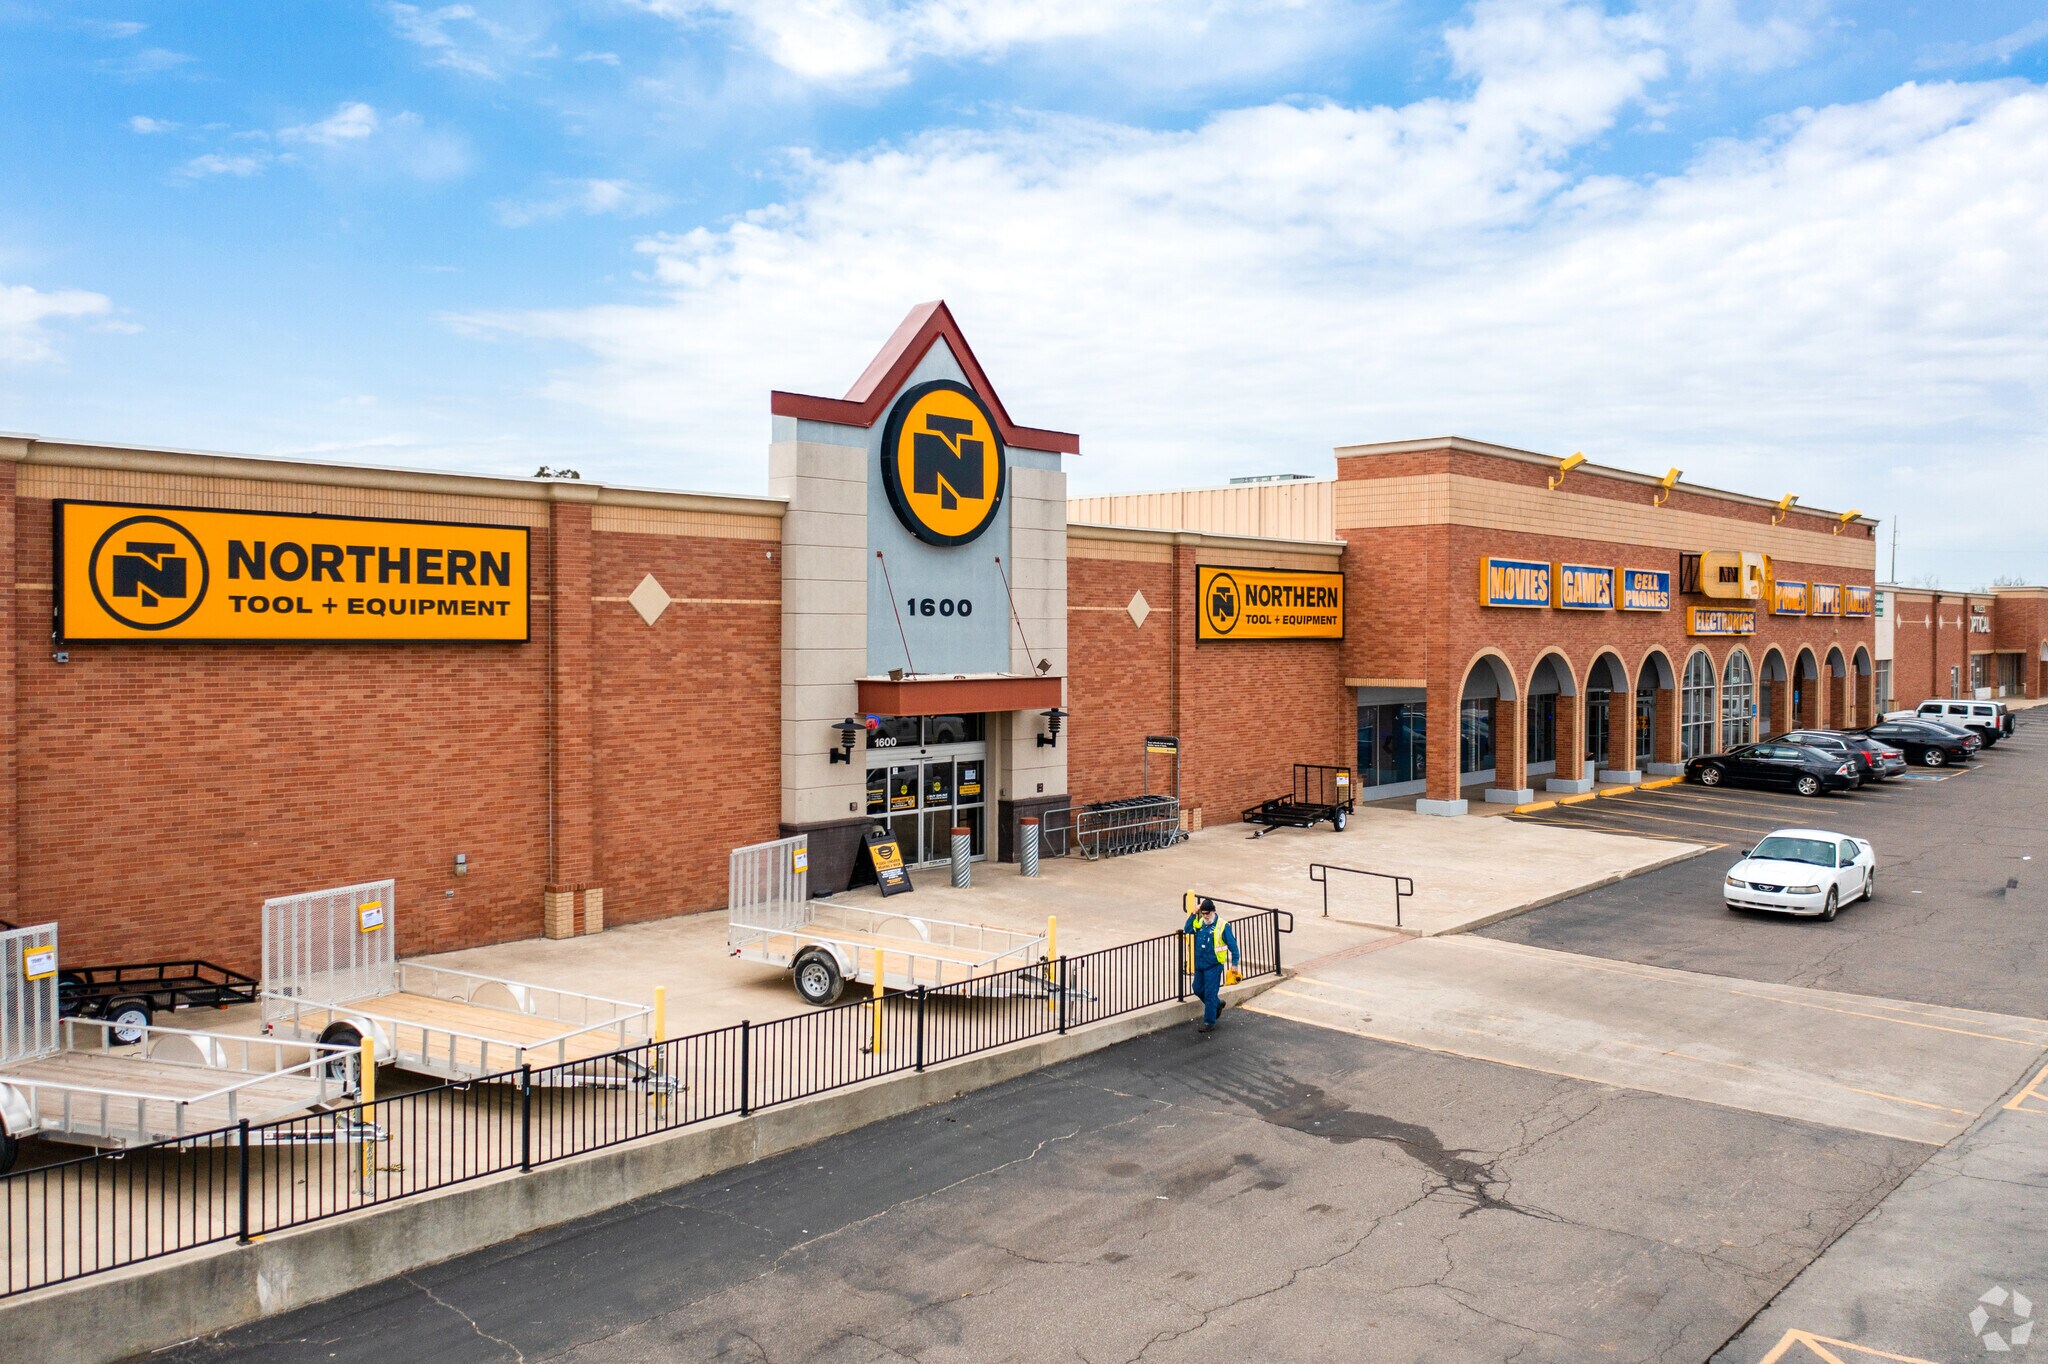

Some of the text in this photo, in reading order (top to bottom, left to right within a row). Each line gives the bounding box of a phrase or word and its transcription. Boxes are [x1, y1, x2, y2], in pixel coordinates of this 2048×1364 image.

[228, 540, 511, 586] NORTHERN
[1490, 566, 1548, 601] MOVIES
[1563, 570, 1611, 604] GAMES
[1633, 573, 1659, 590] CELL
[228, 595, 511, 617] TOOL + EQUIPMENT
[1245, 584, 1338, 608] NORTHERN
[1625, 589, 1669, 607] PHONES
[1814, 587, 1841, 612] APPLE
[907, 598, 973, 617] 1600
[1246, 615, 1272, 625] TOOL
[1282, 615, 1338, 625] EQUIPMENT
[1696, 612, 1755, 632] ELECTRONICS
[875, 737, 897, 748] 1600
